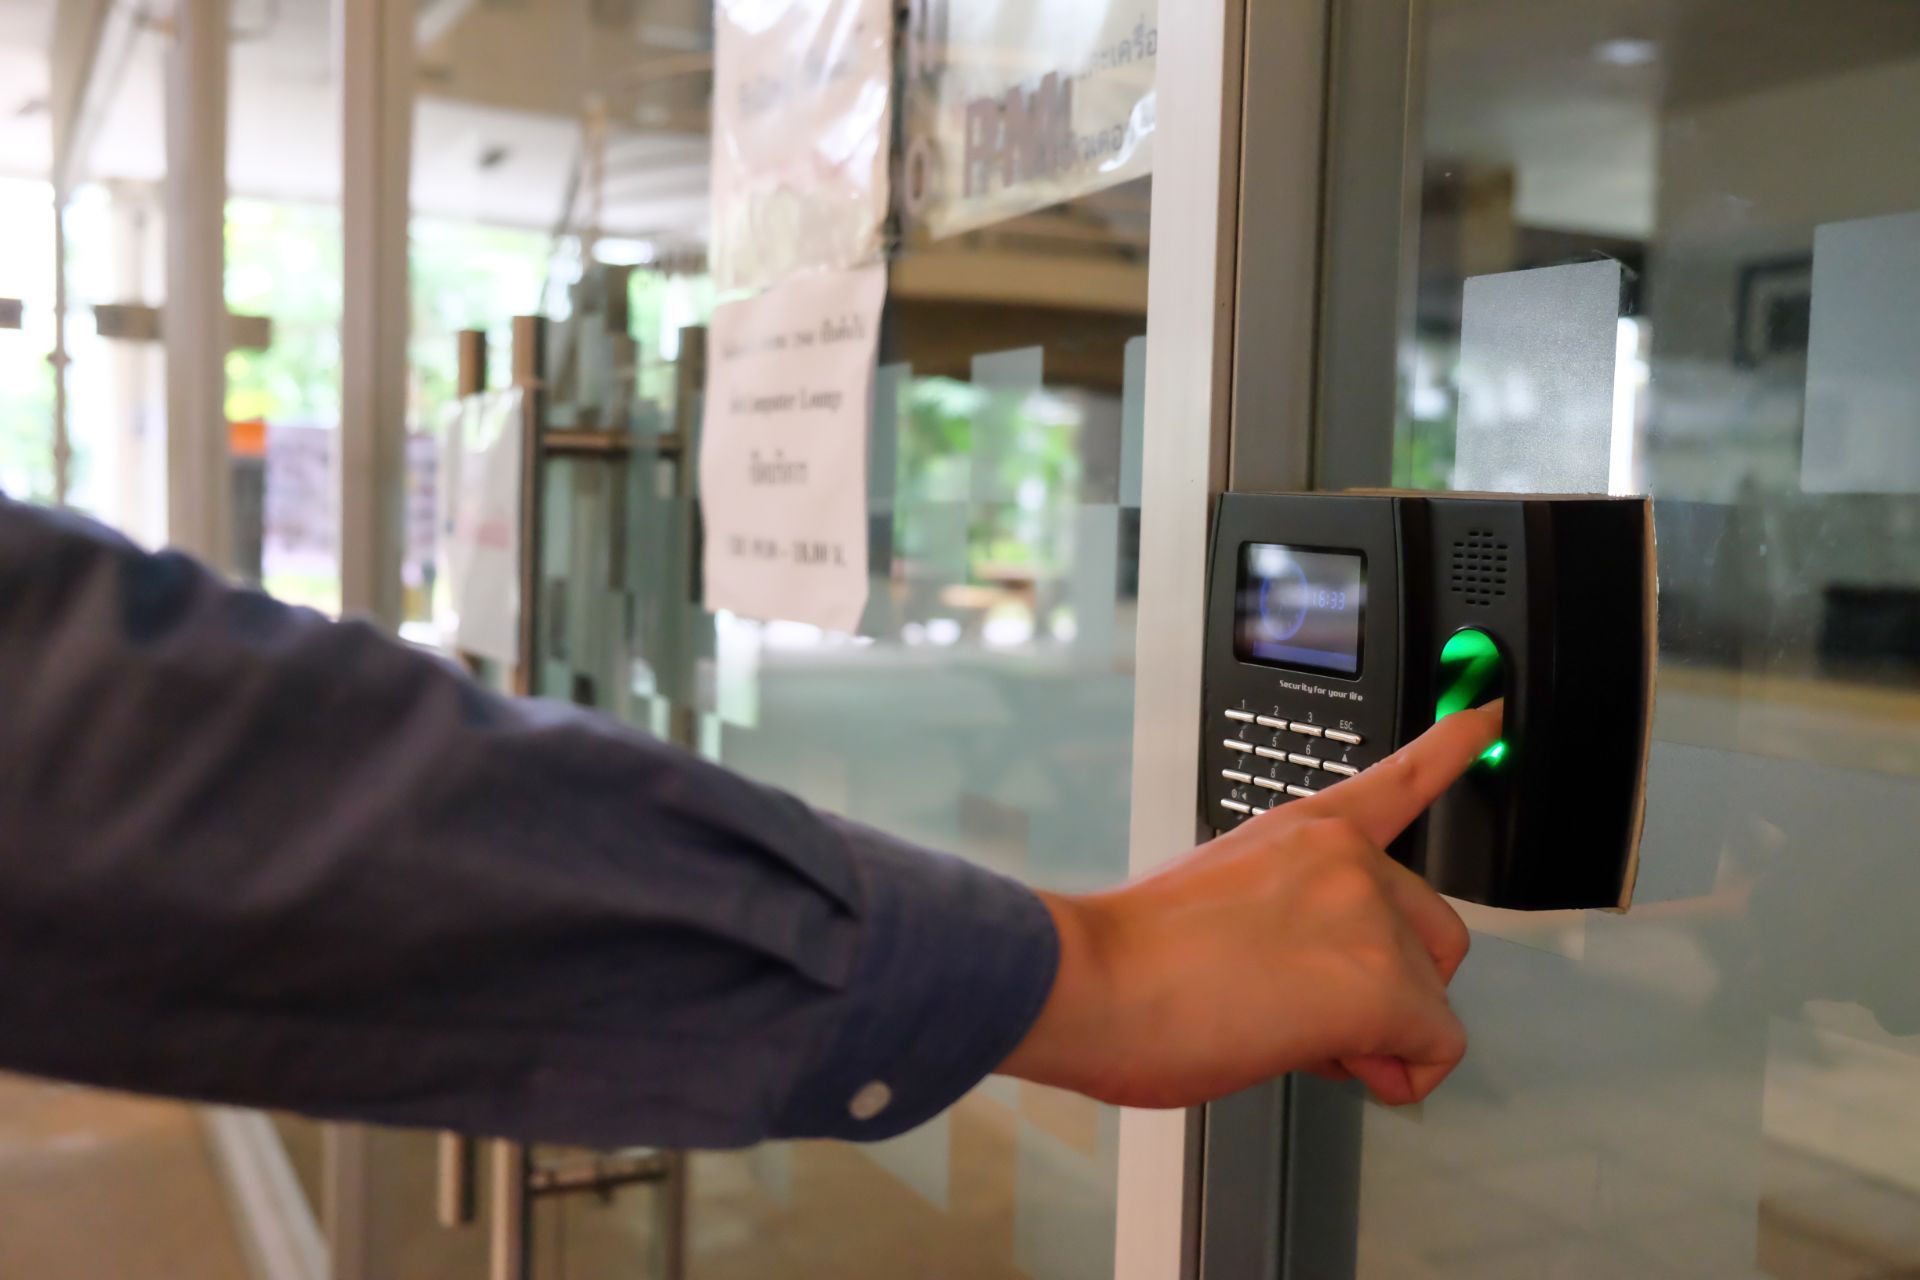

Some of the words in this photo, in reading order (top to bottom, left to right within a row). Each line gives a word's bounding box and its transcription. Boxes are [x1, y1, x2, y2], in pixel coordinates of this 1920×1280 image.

[1279, 679, 1313, 694] Security
[1313, 685, 1327, 695] for
[1328, 689, 1348, 698] your
[1349, 691, 1363, 701] life
[1273, 705, 1279, 716] 2
[1307, 711, 1313, 723] 3
[1339, 719, 1353, 731] ESC
[1238, 729, 1244, 740] 4
[1271, 736, 1277, 748] 5
[1305, 744, 1311, 755] 6
[1270, 767, 1276, 779] 8
[1303, 776, 1310, 787] 9
[1268, 798, 1274, 809] 0
